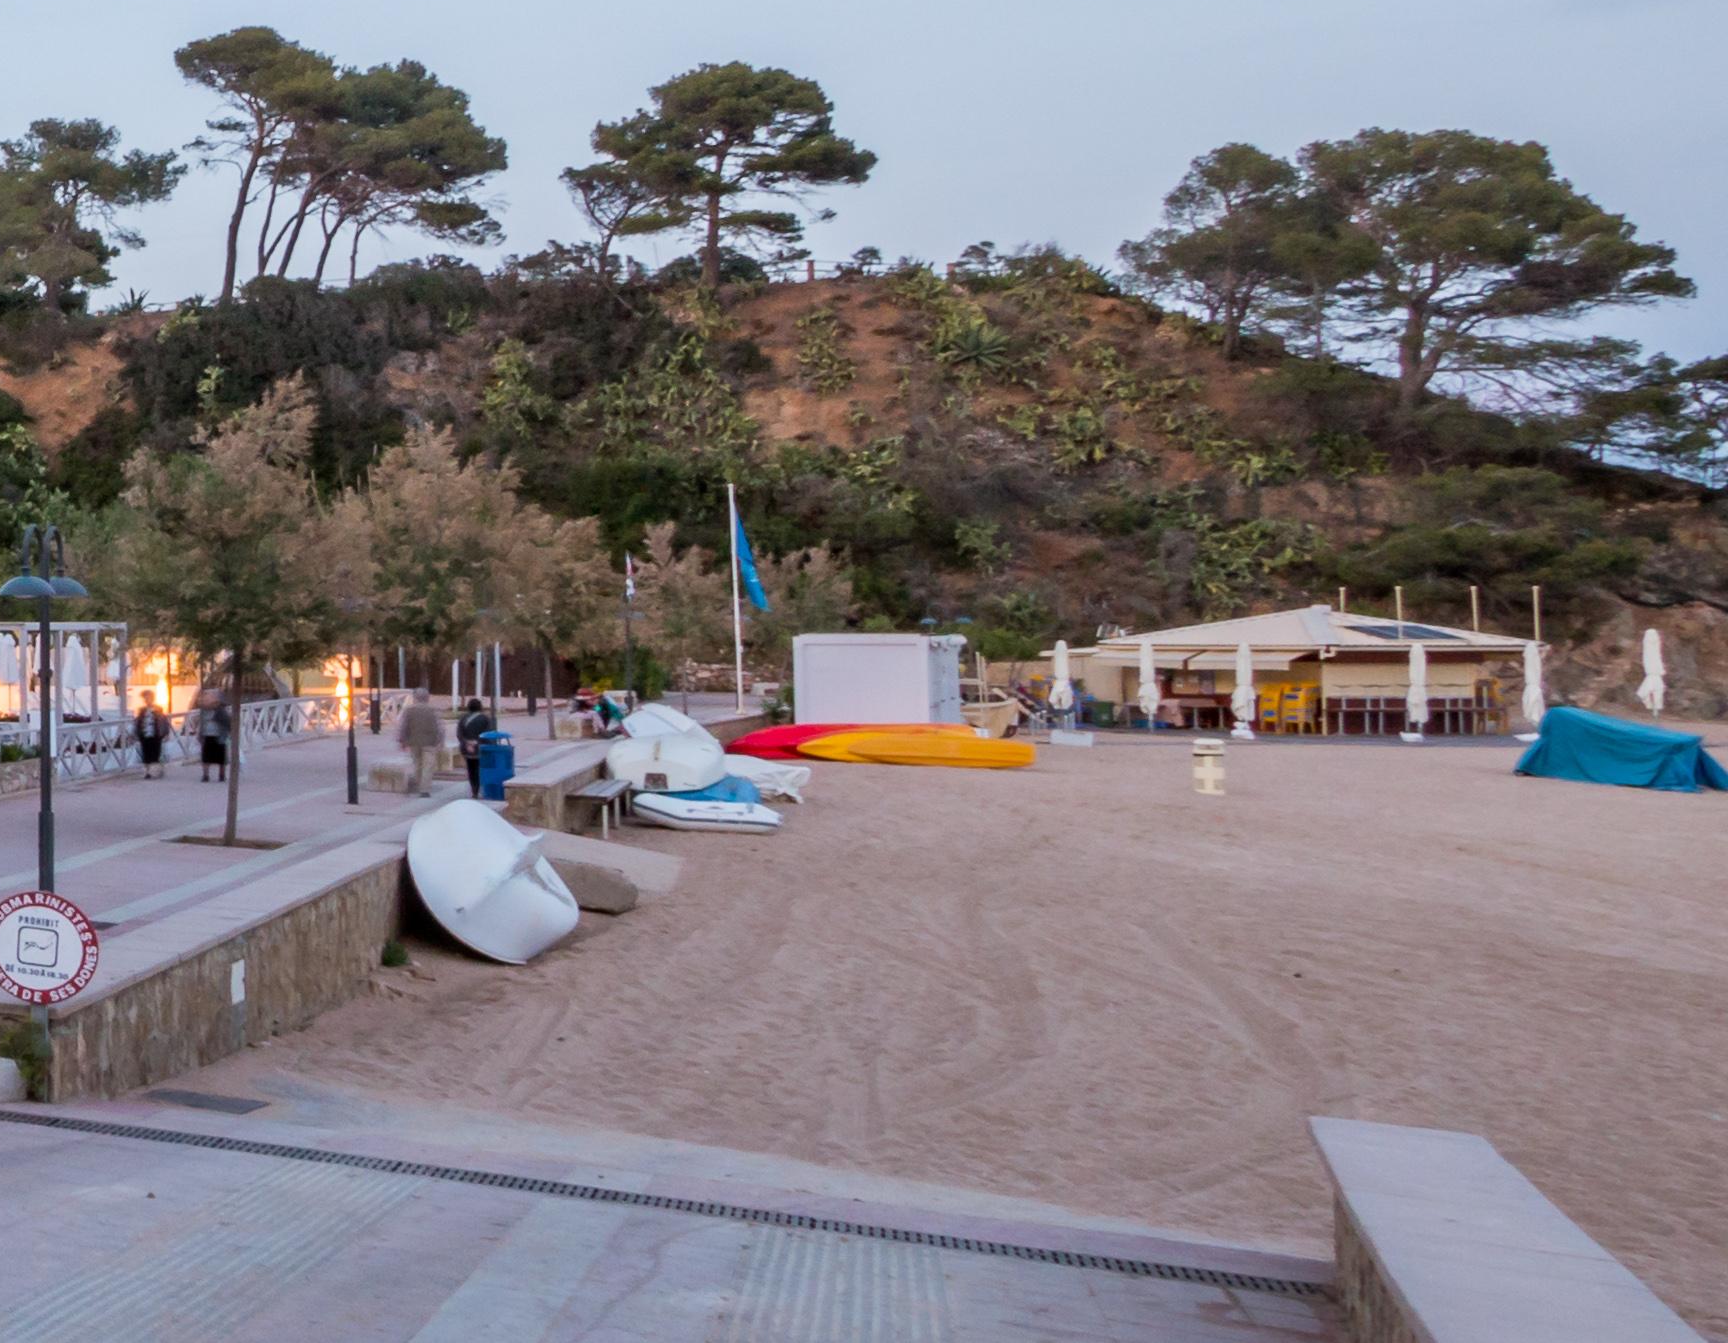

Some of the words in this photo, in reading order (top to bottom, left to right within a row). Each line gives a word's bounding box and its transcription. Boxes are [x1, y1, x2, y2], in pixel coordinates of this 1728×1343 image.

[18, 915, 59, 927] PROHIBIT
[21, 989, 43, 1003] DE
[49, 983, 76, 1002] SES
[73, 945, 98, 988] DONES
